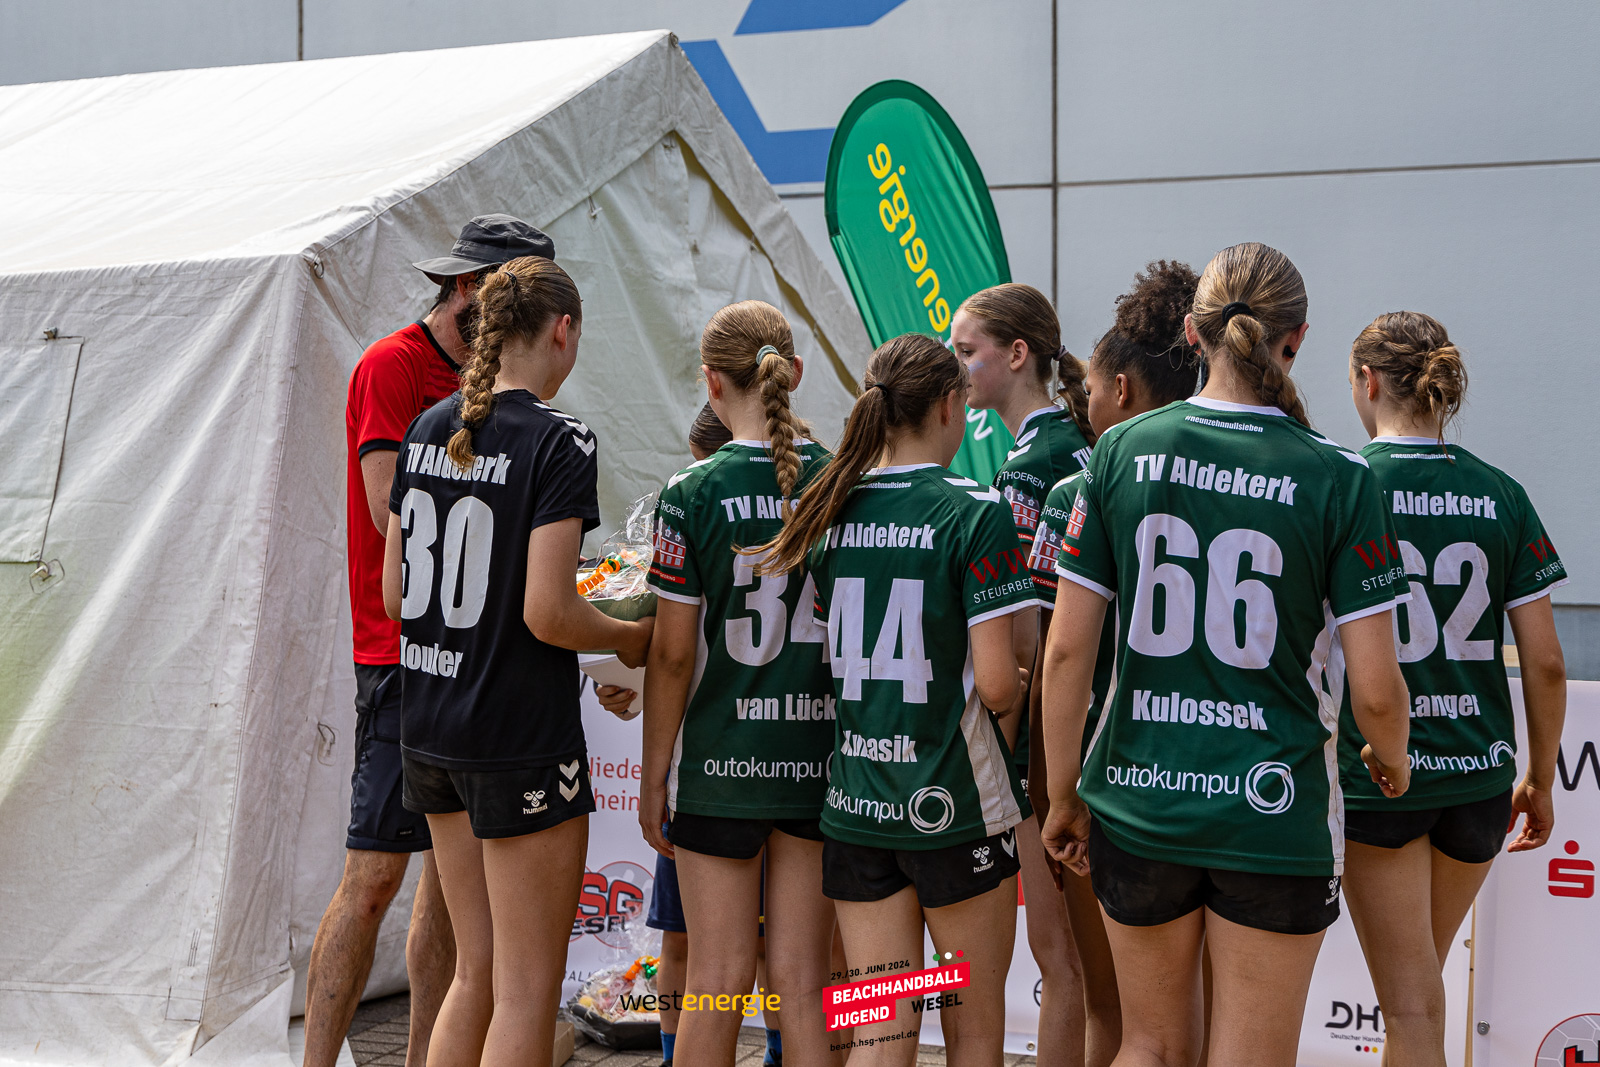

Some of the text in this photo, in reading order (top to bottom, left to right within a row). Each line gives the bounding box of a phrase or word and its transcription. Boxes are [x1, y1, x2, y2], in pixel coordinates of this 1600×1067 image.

[406, 442, 424, 473] TV
[1003, 471, 1045, 489] THOEREN
[1134, 454, 1167, 483] TV
[1170, 456, 1298, 506] Aldekerk
[721, 495, 751, 523] TV
[1393, 490, 1498, 520] Aldekerk
[841, 523, 936, 550] Aldekerk
[401, 488, 494, 629] 30
[1128, 513, 1284, 670] 66
[1393, 540, 1495, 664] 62
[828, 577, 934, 703] 44
[736, 694, 836, 721] van Lück
[1132, 690, 1268, 731] Kulossek
[704, 756, 822, 783] outokumpu
[1106, 763, 1240, 799] outokumpu
[577, 871, 644, 921] SG
[1325, 1000, 1386, 1033] DH
